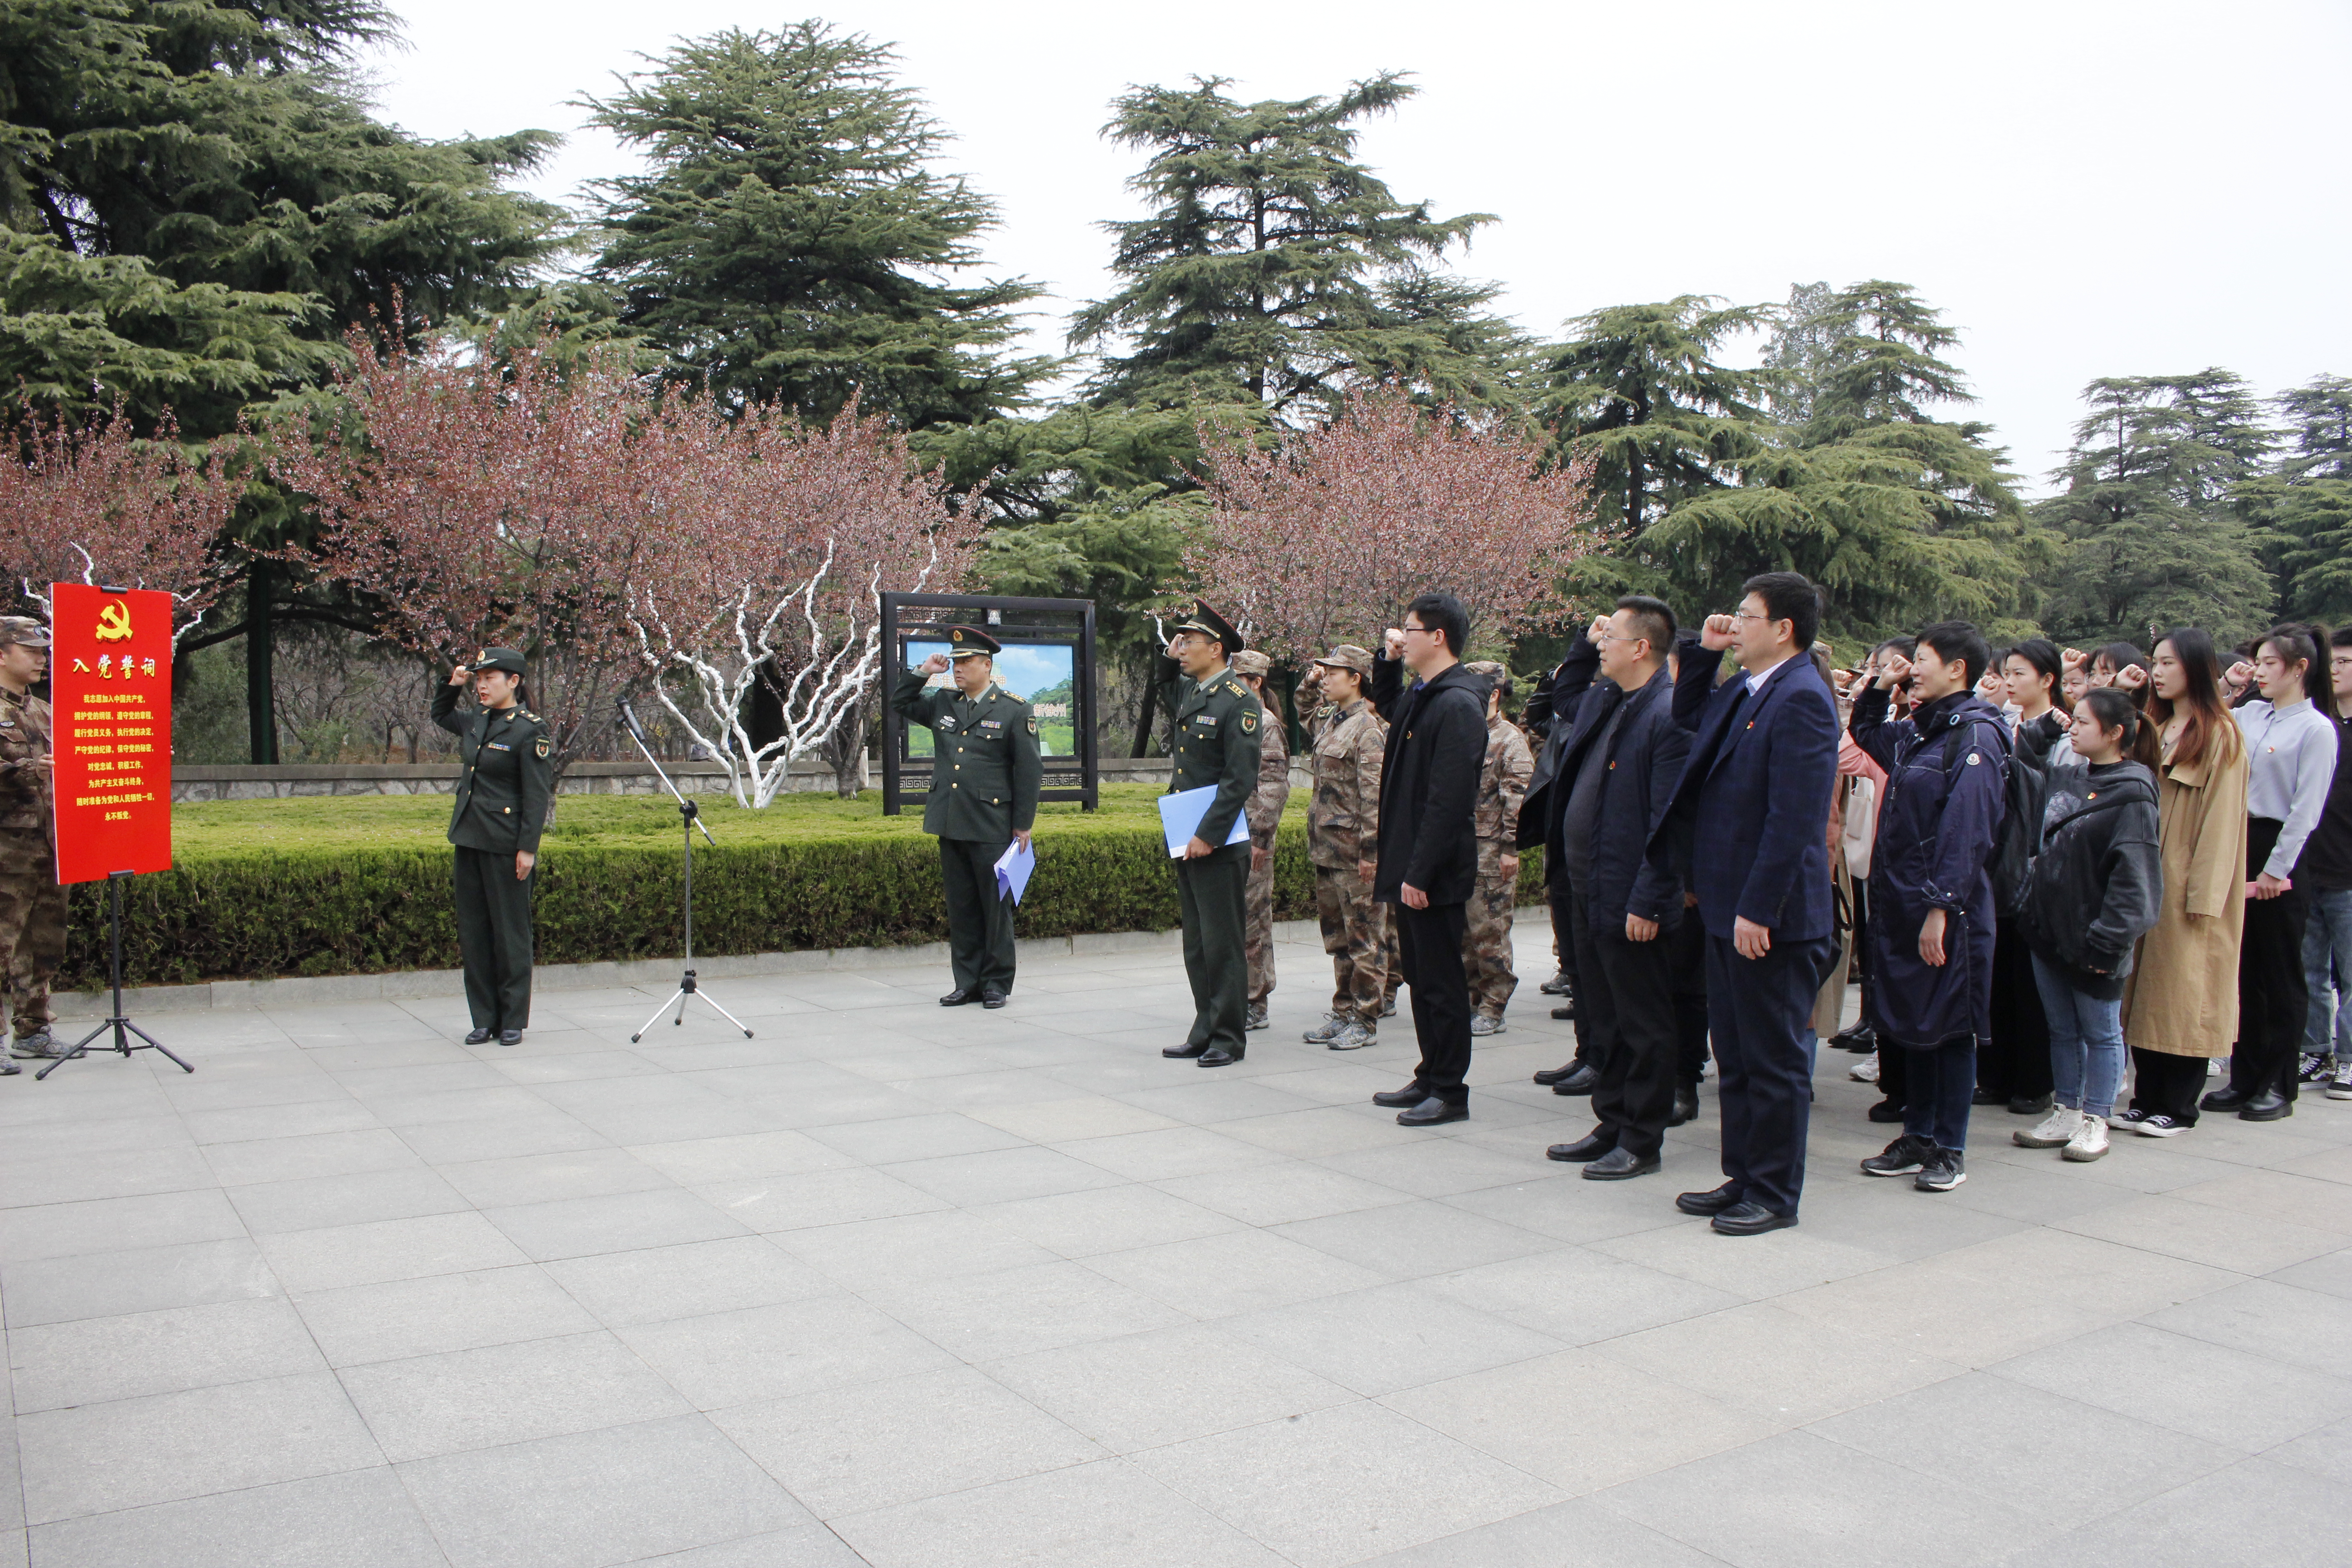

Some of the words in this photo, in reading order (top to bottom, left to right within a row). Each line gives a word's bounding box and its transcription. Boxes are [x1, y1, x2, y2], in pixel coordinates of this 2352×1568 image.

[73, 654, 155, 680] 入党誓词
[83, 694, 146, 704] 我志愿加入中国共产党，
[1034, 703, 1066, 717] 新徐州
[88, 777, 144, 789] 为共产主义奋斗终身，
[76, 792, 155, 806] 随时准备为党和人民牺牲一切，
[105, 810, 132, 821] 永不叛党。
